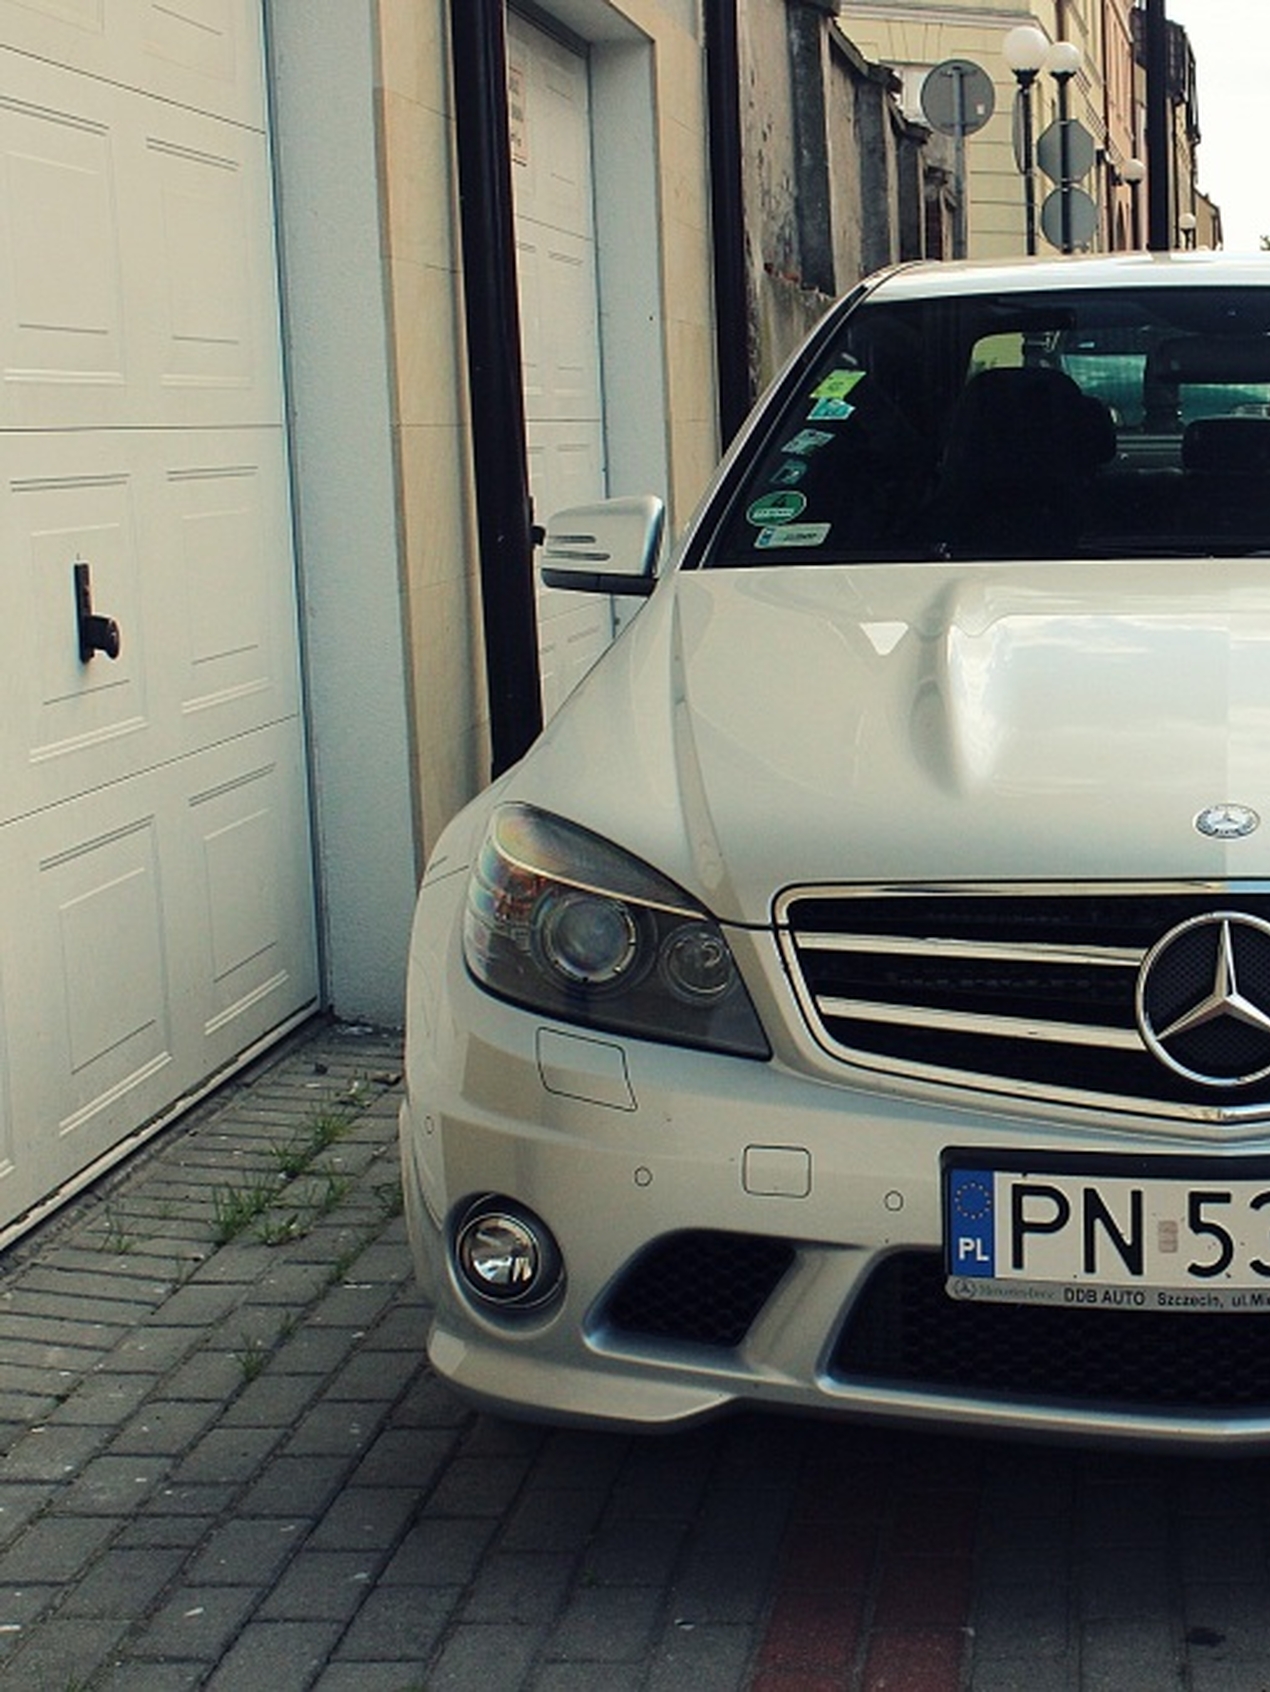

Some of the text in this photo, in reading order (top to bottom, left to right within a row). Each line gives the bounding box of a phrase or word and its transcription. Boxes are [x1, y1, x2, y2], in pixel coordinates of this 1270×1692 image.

[1011, 1183, 1144, 1276] PN
[958, 1237, 989, 1262] PL
[1063, 1287, 1097, 1303] DDB
[1101, 1289, 1146, 1306] AUTO
